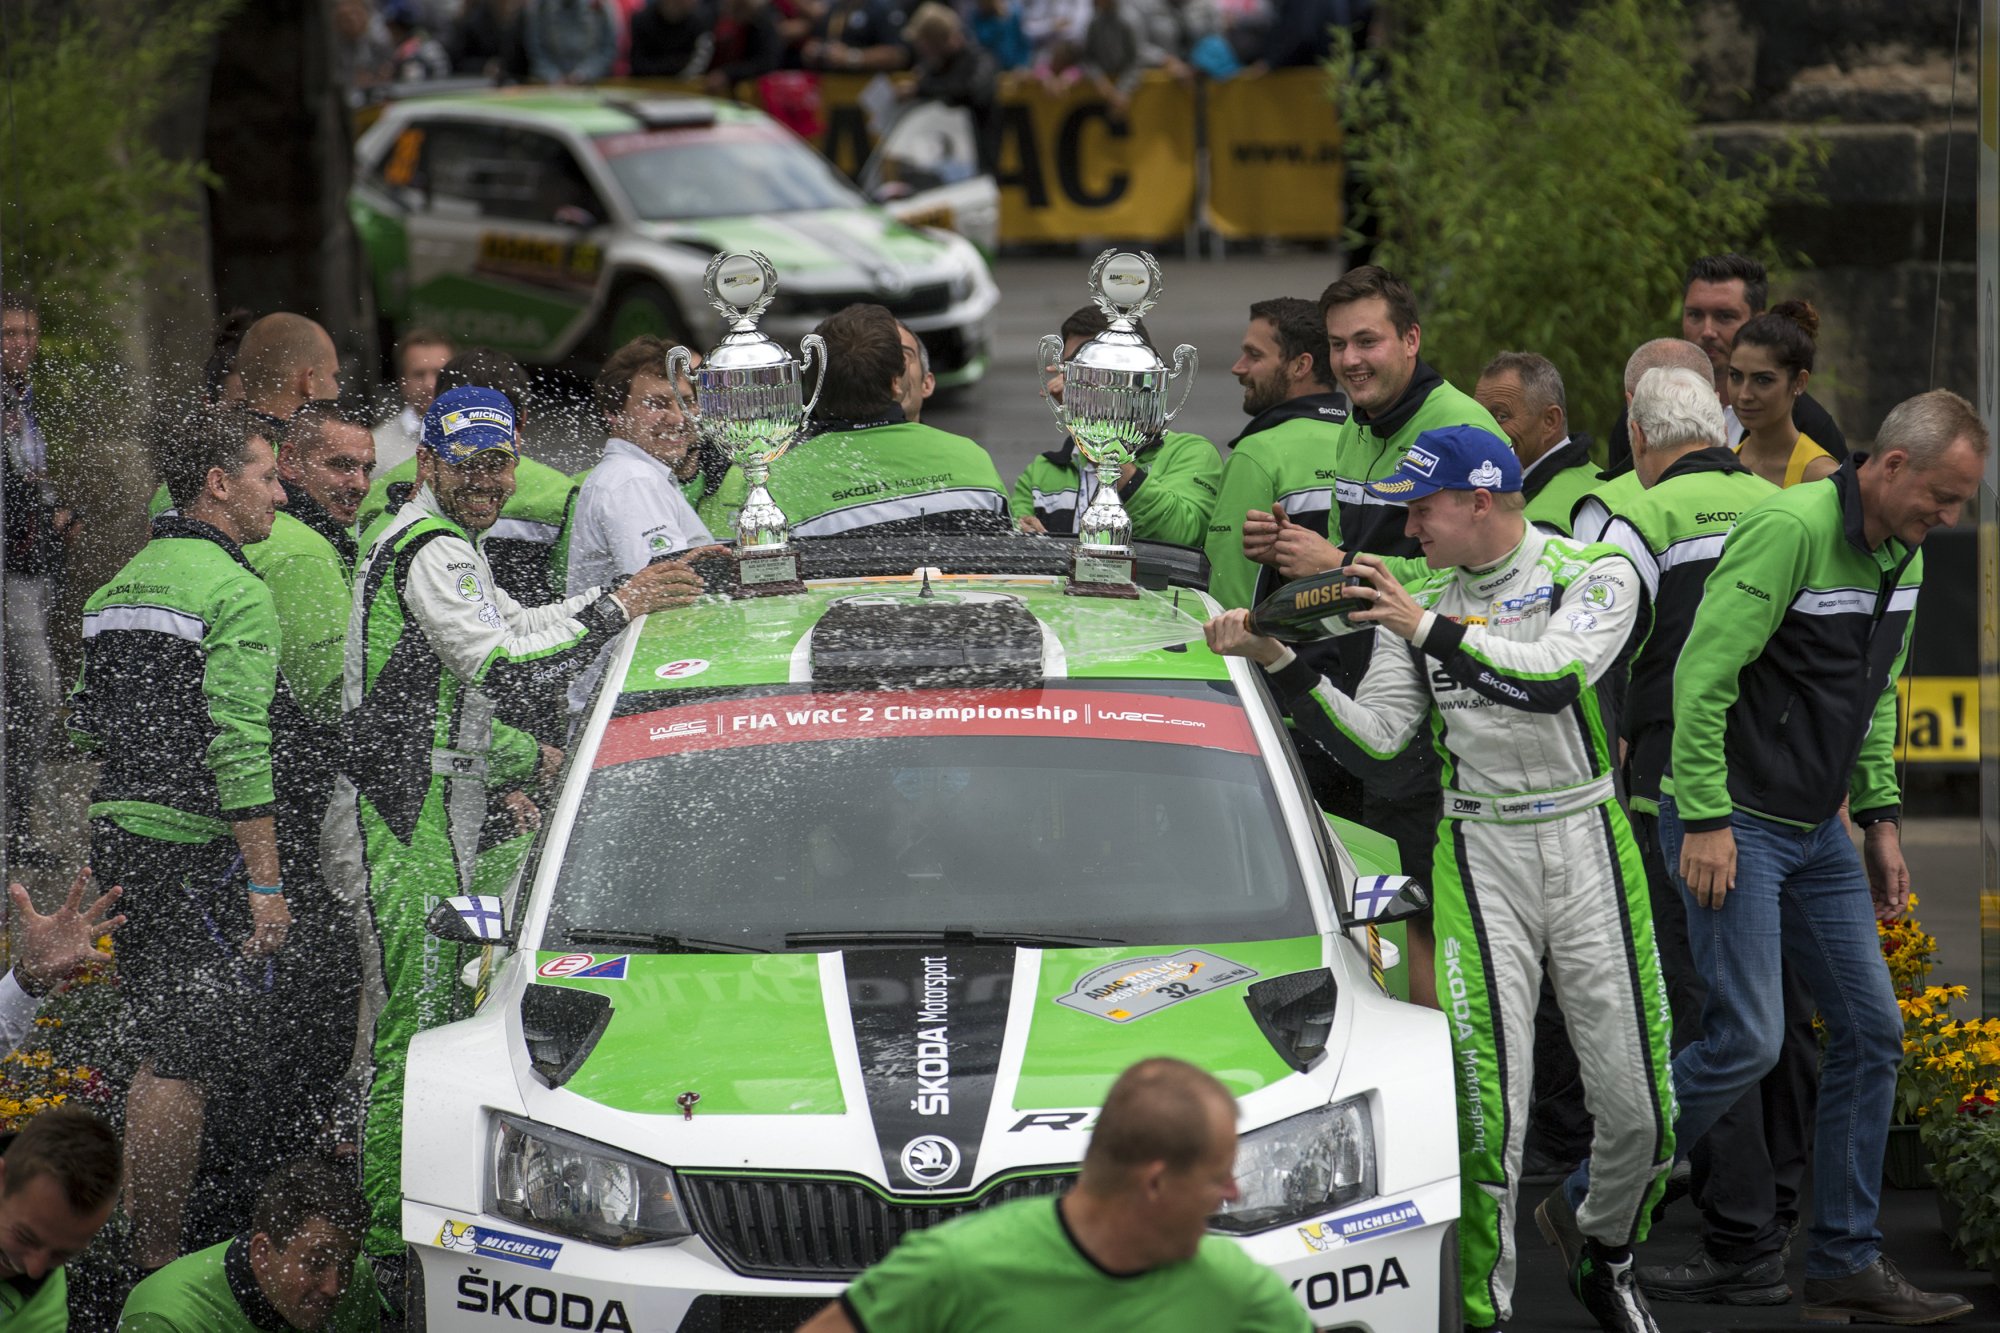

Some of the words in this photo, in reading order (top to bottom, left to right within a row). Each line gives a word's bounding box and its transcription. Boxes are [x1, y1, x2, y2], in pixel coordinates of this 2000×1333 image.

[469, 411, 512, 427] MICHELIN
[895, 472, 954, 490] Motorsport
[1695, 511, 1743, 525] ŠKOD
[1478, 671, 1530, 703] ŠKODA
[1439, 695, 1498, 711] www.sko
[733, 713, 778, 731] FIA
[786, 708, 848, 726] WRC
[858, 706, 875, 722] 2
[884, 704, 1078, 724] Championship
[1453, 798, 1482, 812] OMP
[917, 956, 956, 1022] Motorsport
[1084, 979, 1133, 1001] ADAC
[1124, 960, 1187, 985] RALLYE
[1104, 970, 1190, 1004] DEUTSCHLAND
[1156, 981, 1201, 1000] 32
[1444, 936, 1474, 1043] ŠKODA
[1461, 1048, 1487, 1154] Motorsport
[910, 1026, 950, 1116] ŠKODA
[1343, 1206, 1419, 1234] MICHELIN
[481, 1235, 561, 1260] MICHELIN
[1289, 1256, 1410, 1310] ODA
[457, 1266, 633, 1333] ŠKODA
